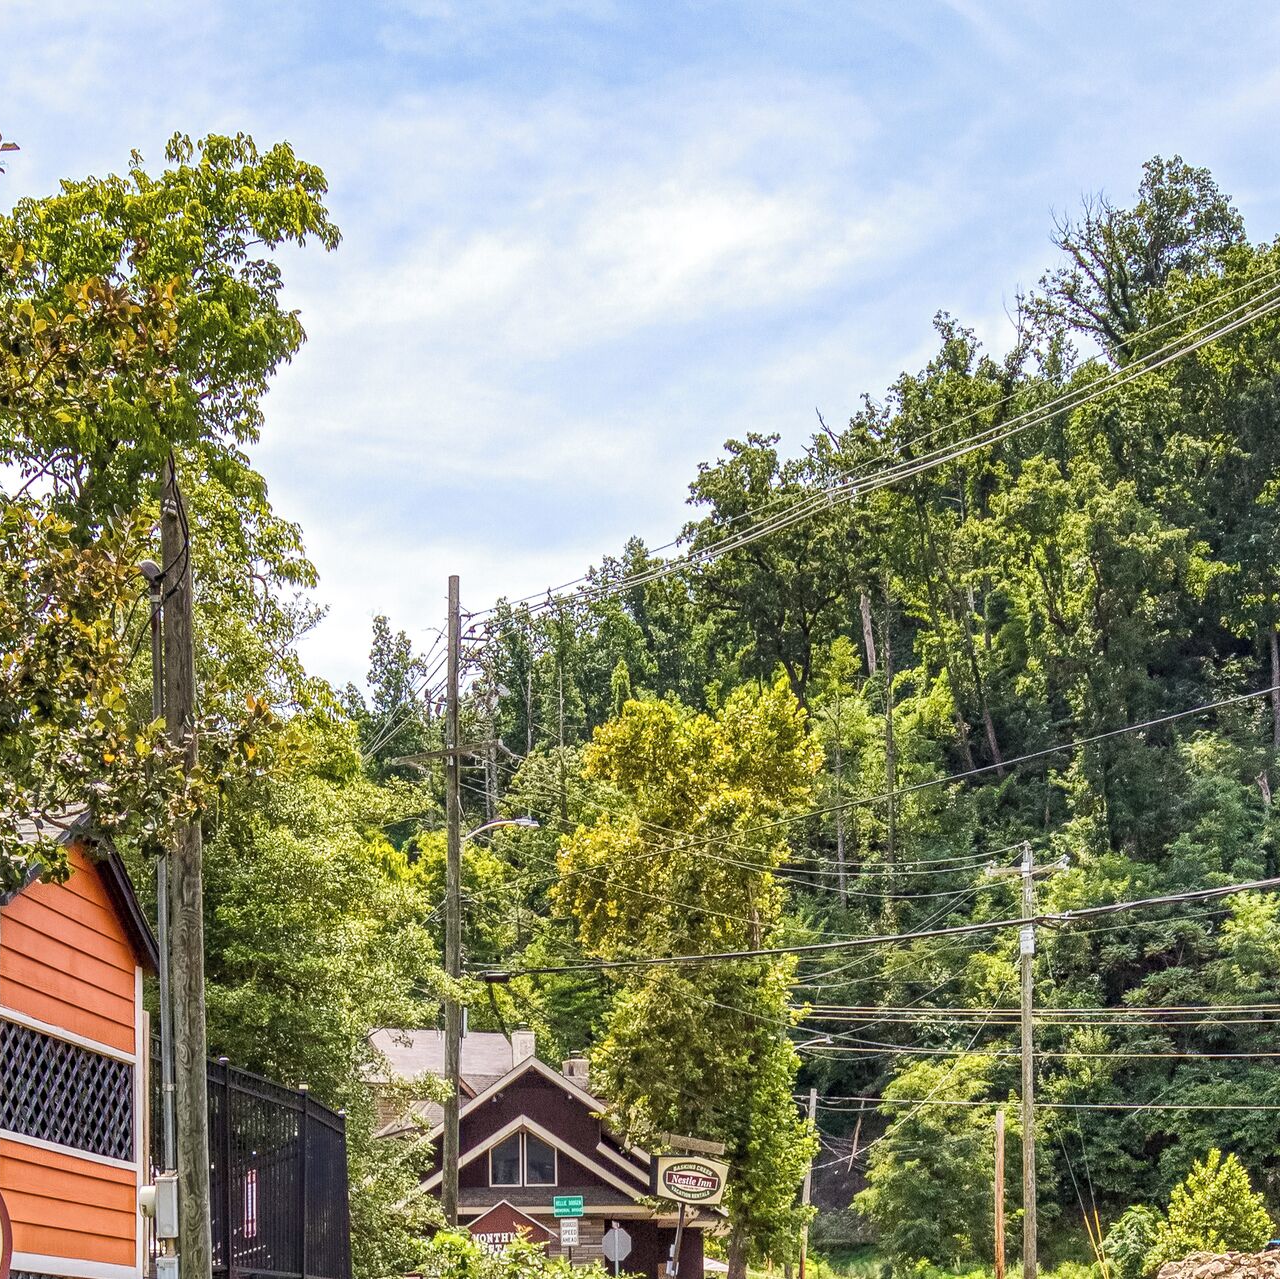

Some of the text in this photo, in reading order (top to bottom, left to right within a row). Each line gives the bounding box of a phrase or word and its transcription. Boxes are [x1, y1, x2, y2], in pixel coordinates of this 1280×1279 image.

[696, 1165, 713, 1177] CREEK
[671, 1174, 696, 1186] Nestle
[696, 1178, 712, 1188] Inn
